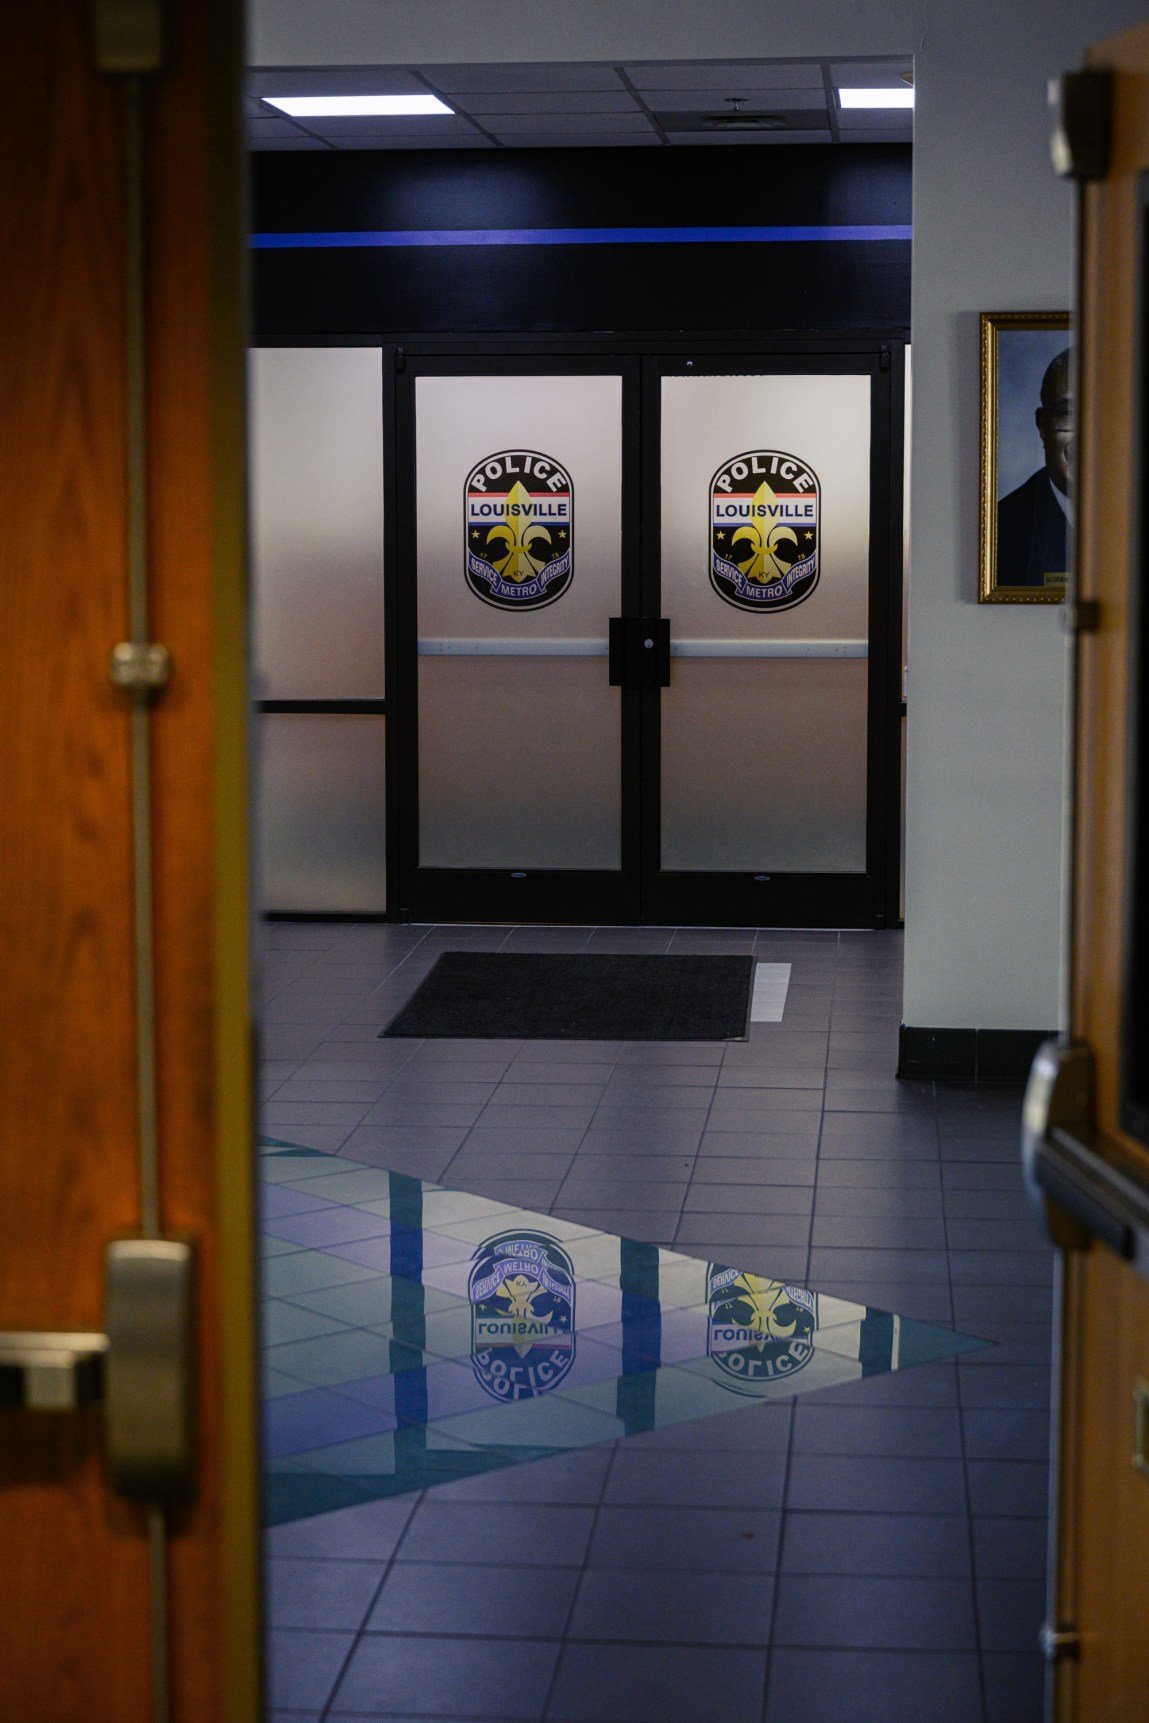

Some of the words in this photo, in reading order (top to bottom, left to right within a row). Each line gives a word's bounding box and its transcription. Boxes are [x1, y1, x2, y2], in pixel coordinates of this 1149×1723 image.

[471, 456, 567, 492] POLICE
[716, 456, 814, 493] POLICE
[471, 503, 567, 517] LOUISVILLE
[716, 504, 814, 518] LOUISVILLE
[471, 559, 498, 586] SERVICE
[540, 557, 570, 585] INTEGRITY
[715, 560, 743, 587] SERVICE
[786, 558, 816, 586] INTEGRITY
[501, 583, 537, 597] METRO
[746, 585, 783, 598] METRO
